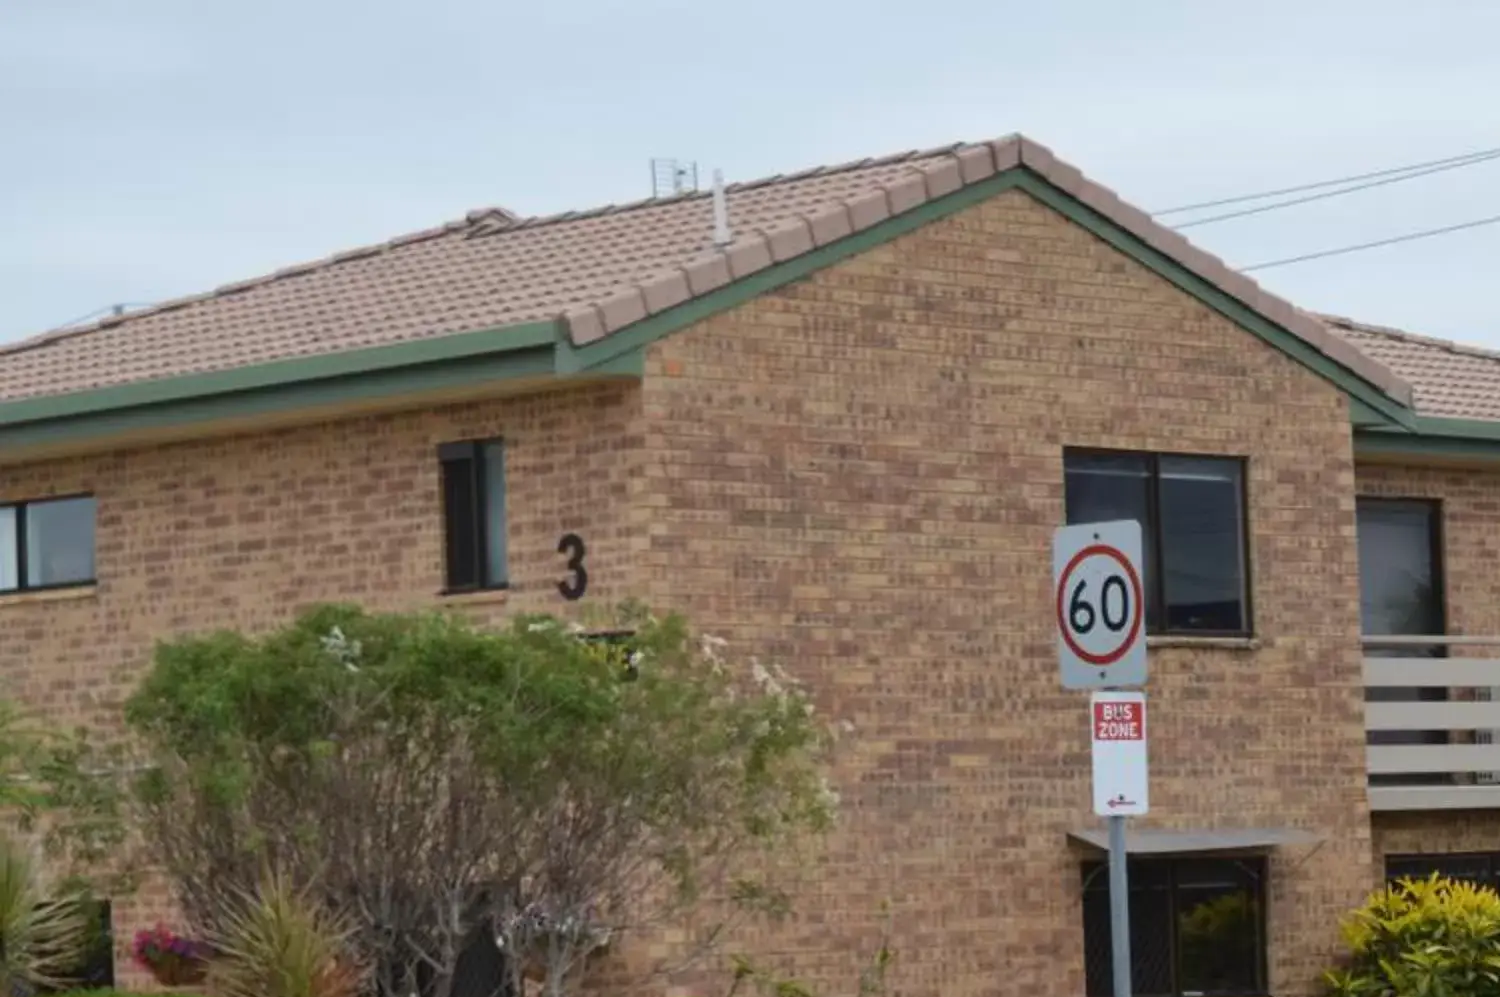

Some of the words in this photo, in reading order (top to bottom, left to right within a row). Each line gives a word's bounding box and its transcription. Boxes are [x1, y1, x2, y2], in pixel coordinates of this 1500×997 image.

[557, 533, 587, 601] 3
[1069, 574, 1129, 634] 60
[1098, 722, 1140, 738] ZONE
[1102, 704, 1134, 721] BUS
